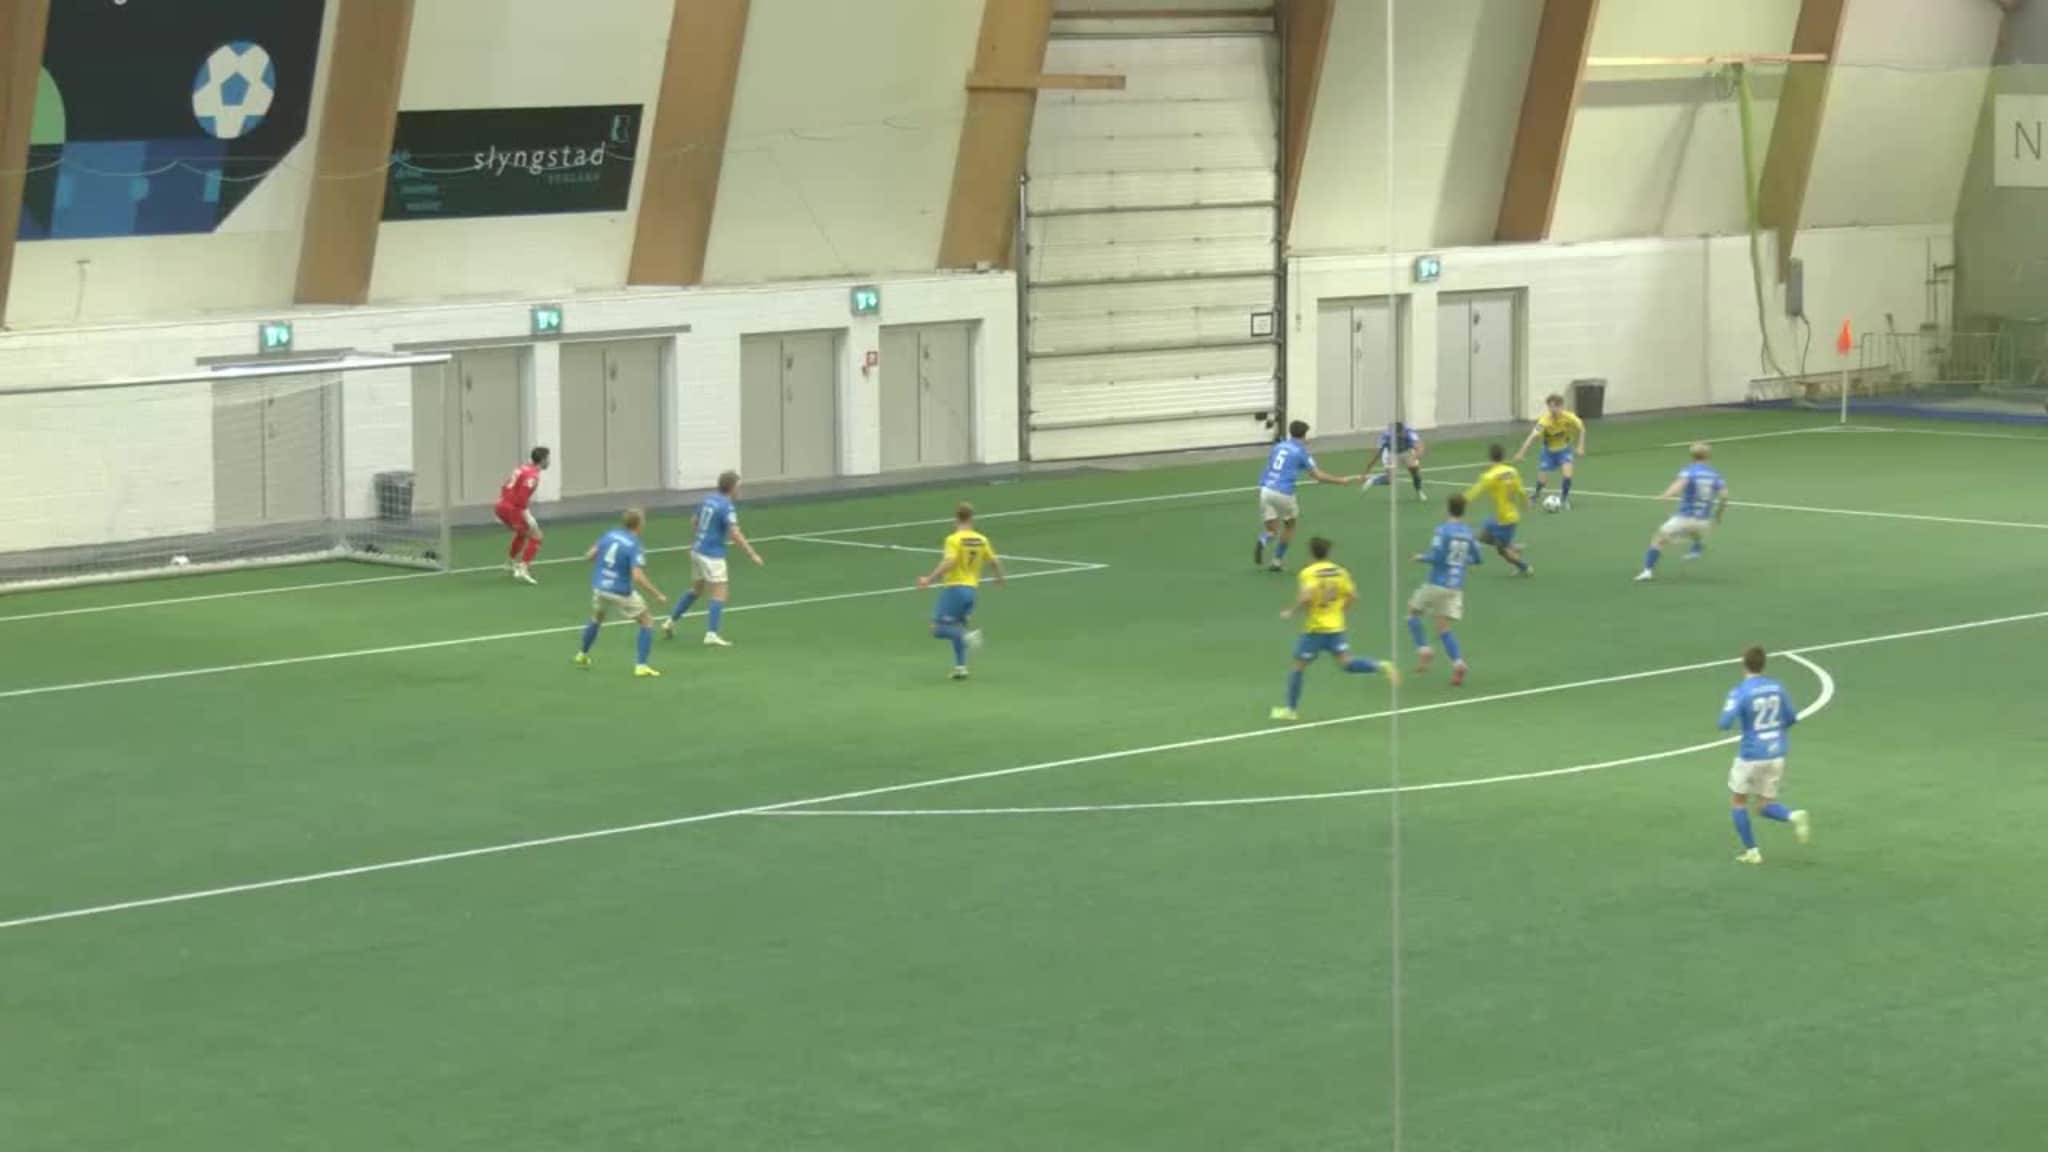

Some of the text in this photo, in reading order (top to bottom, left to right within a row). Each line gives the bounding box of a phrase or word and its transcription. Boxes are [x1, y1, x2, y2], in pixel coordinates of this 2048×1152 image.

[474, 142, 605, 176] slyngstad
[603, 542, 620, 567] 4
[1752, 695, 1781, 731] 22
